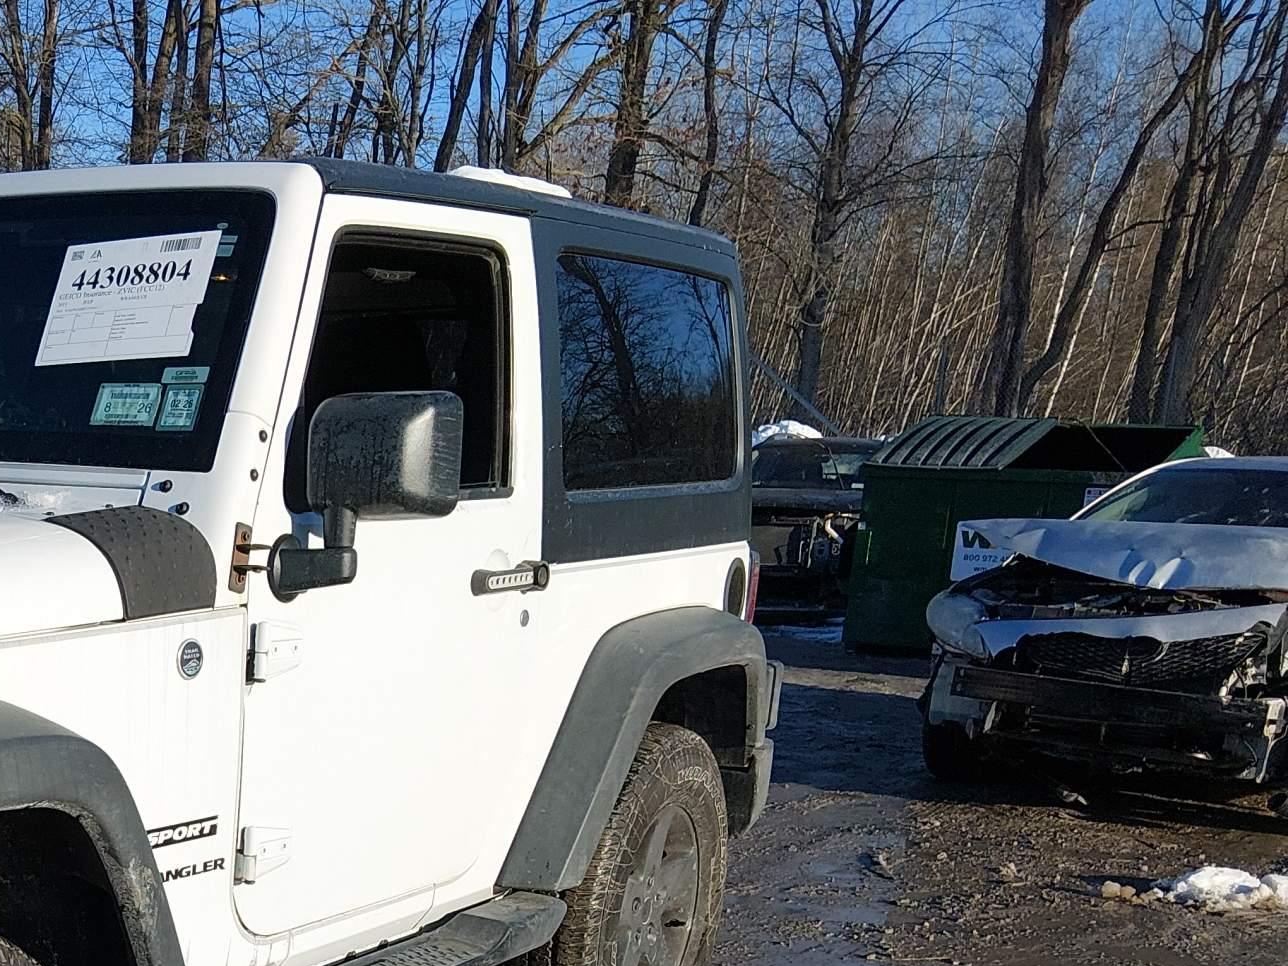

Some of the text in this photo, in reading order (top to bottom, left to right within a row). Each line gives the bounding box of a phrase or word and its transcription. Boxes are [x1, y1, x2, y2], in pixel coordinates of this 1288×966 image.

[72, 258, 193, 291] 44308804
[59, 292, 82, 300] GEICO
[83, 290, 112, 298] Insurance
[117, 286, 137, 294] ZVIC
[103, 402, 153, 414] 8 26
[170, 399, 181, 408] 02
[963, 554, 981, 562] 800
[982, 555, 998, 563] 972
[147, 822, 218, 847] SPORT
